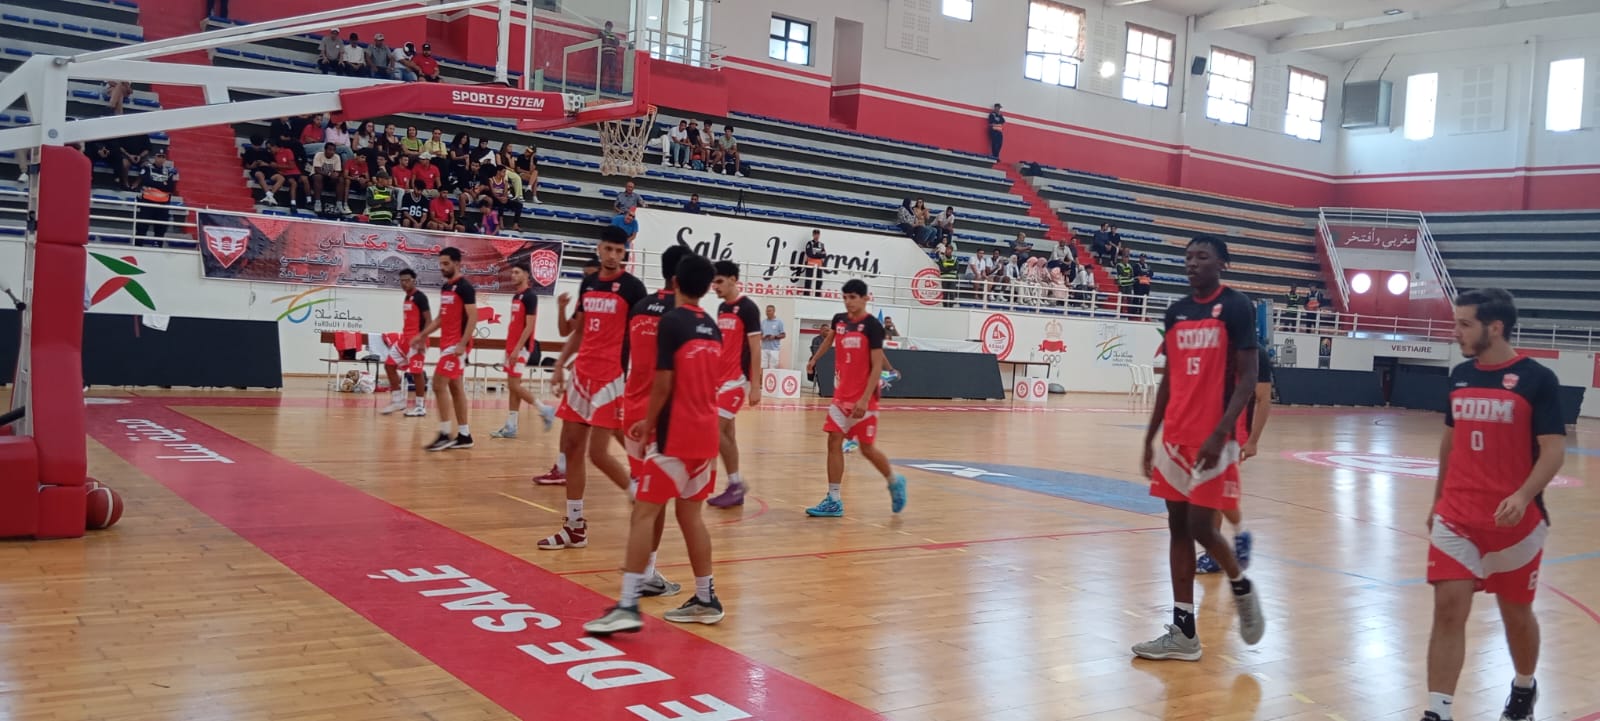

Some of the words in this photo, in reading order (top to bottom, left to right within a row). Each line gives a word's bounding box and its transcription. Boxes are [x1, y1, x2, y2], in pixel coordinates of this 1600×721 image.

[452, 90, 495, 104] SPORT
[495, 95, 545, 108] SYSTEM
[410, 205, 422, 217] 86
[677, 226, 733, 261] Salé
[1391, 343, 1433, 353] VESTIAIRE
[1186, 357, 1200, 375] 15
[1451, 397, 1514, 423] CODM
[366, 564, 561, 632] SALÉ
[516, 636, 676, 690] DE
